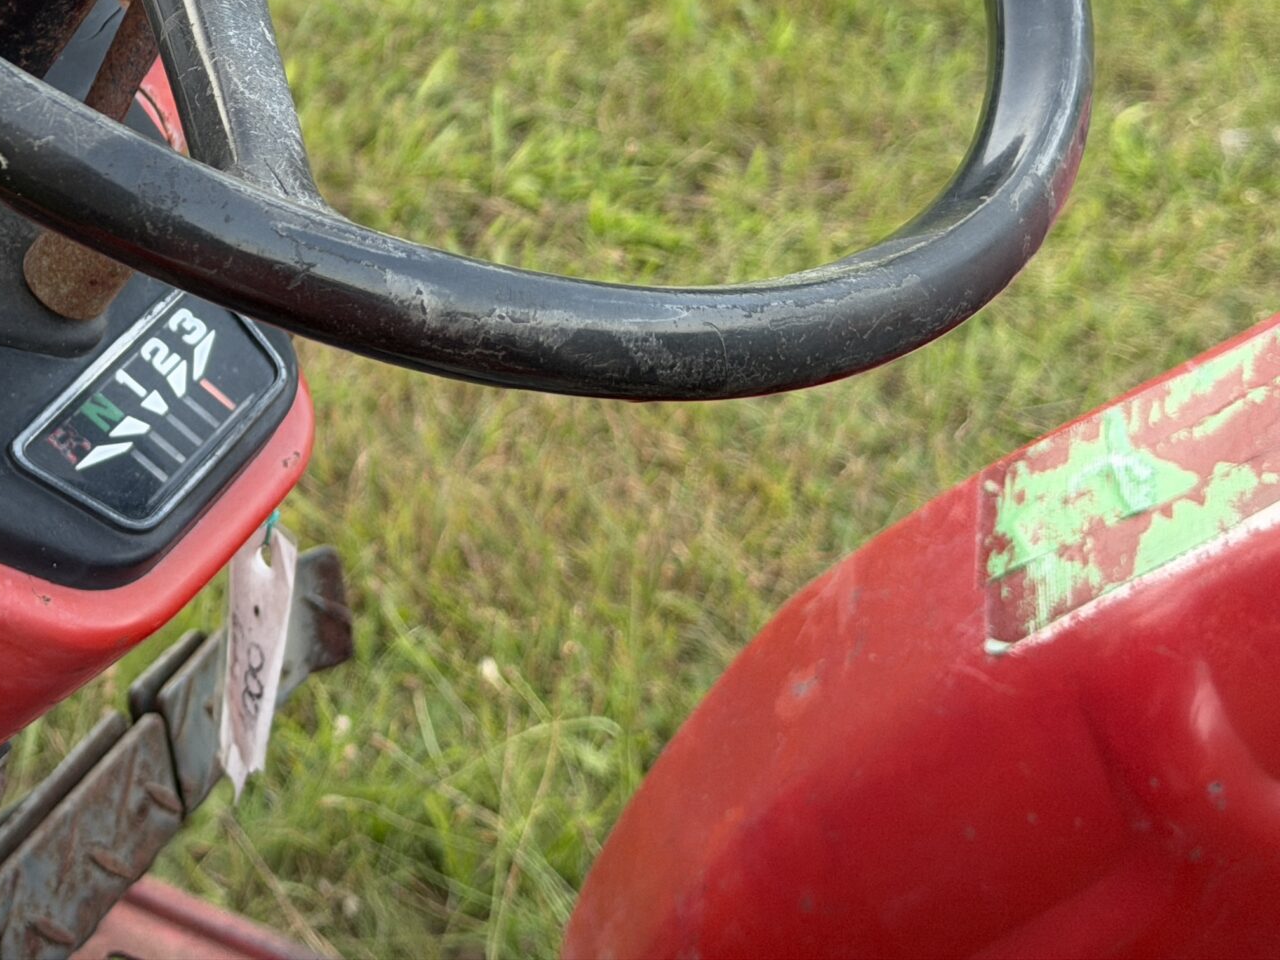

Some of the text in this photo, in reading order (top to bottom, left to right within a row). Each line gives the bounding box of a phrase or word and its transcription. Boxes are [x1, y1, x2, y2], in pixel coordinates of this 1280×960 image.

[80, 392, 125, 433] N
[115, 368, 147, 398] 1
[140, 337, 181, 375] 2
[169, 307, 208, 345] 3
